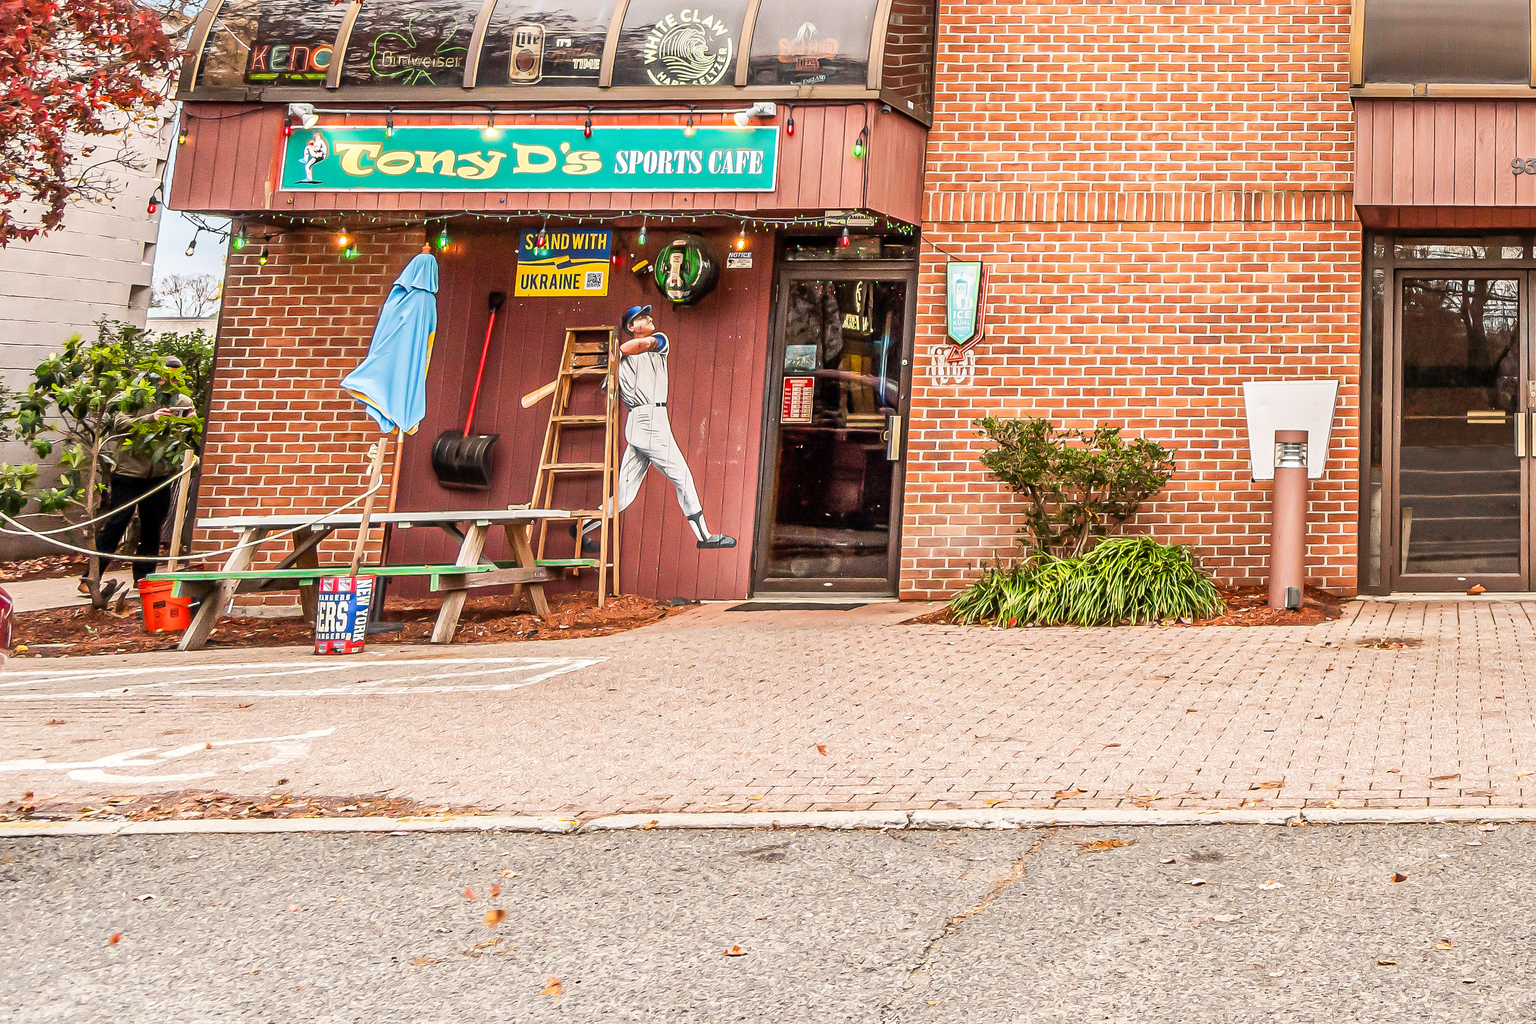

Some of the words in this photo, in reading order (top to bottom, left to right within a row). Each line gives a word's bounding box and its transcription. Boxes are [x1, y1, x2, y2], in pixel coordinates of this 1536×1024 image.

[643, 13, 678, 65] WHITE
[680, 8, 729, 36] CLAW
[250, 44, 334, 72] KENO
[572, 58, 601, 70] TIME
[333, 141, 507, 180] Tony
[512, 141, 603, 176] D's
[614, 149, 703, 175] SPORTS
[707, 149, 764, 175] CAFE
[572, 233, 608, 250] WITH
[728, 251, 753, 259] NOTICE
[520, 274, 582, 290] UKRAINE
[953, 310, 972, 319] ICE
[356, 578, 373, 606] NEW
[352, 607, 368, 643] YORK
